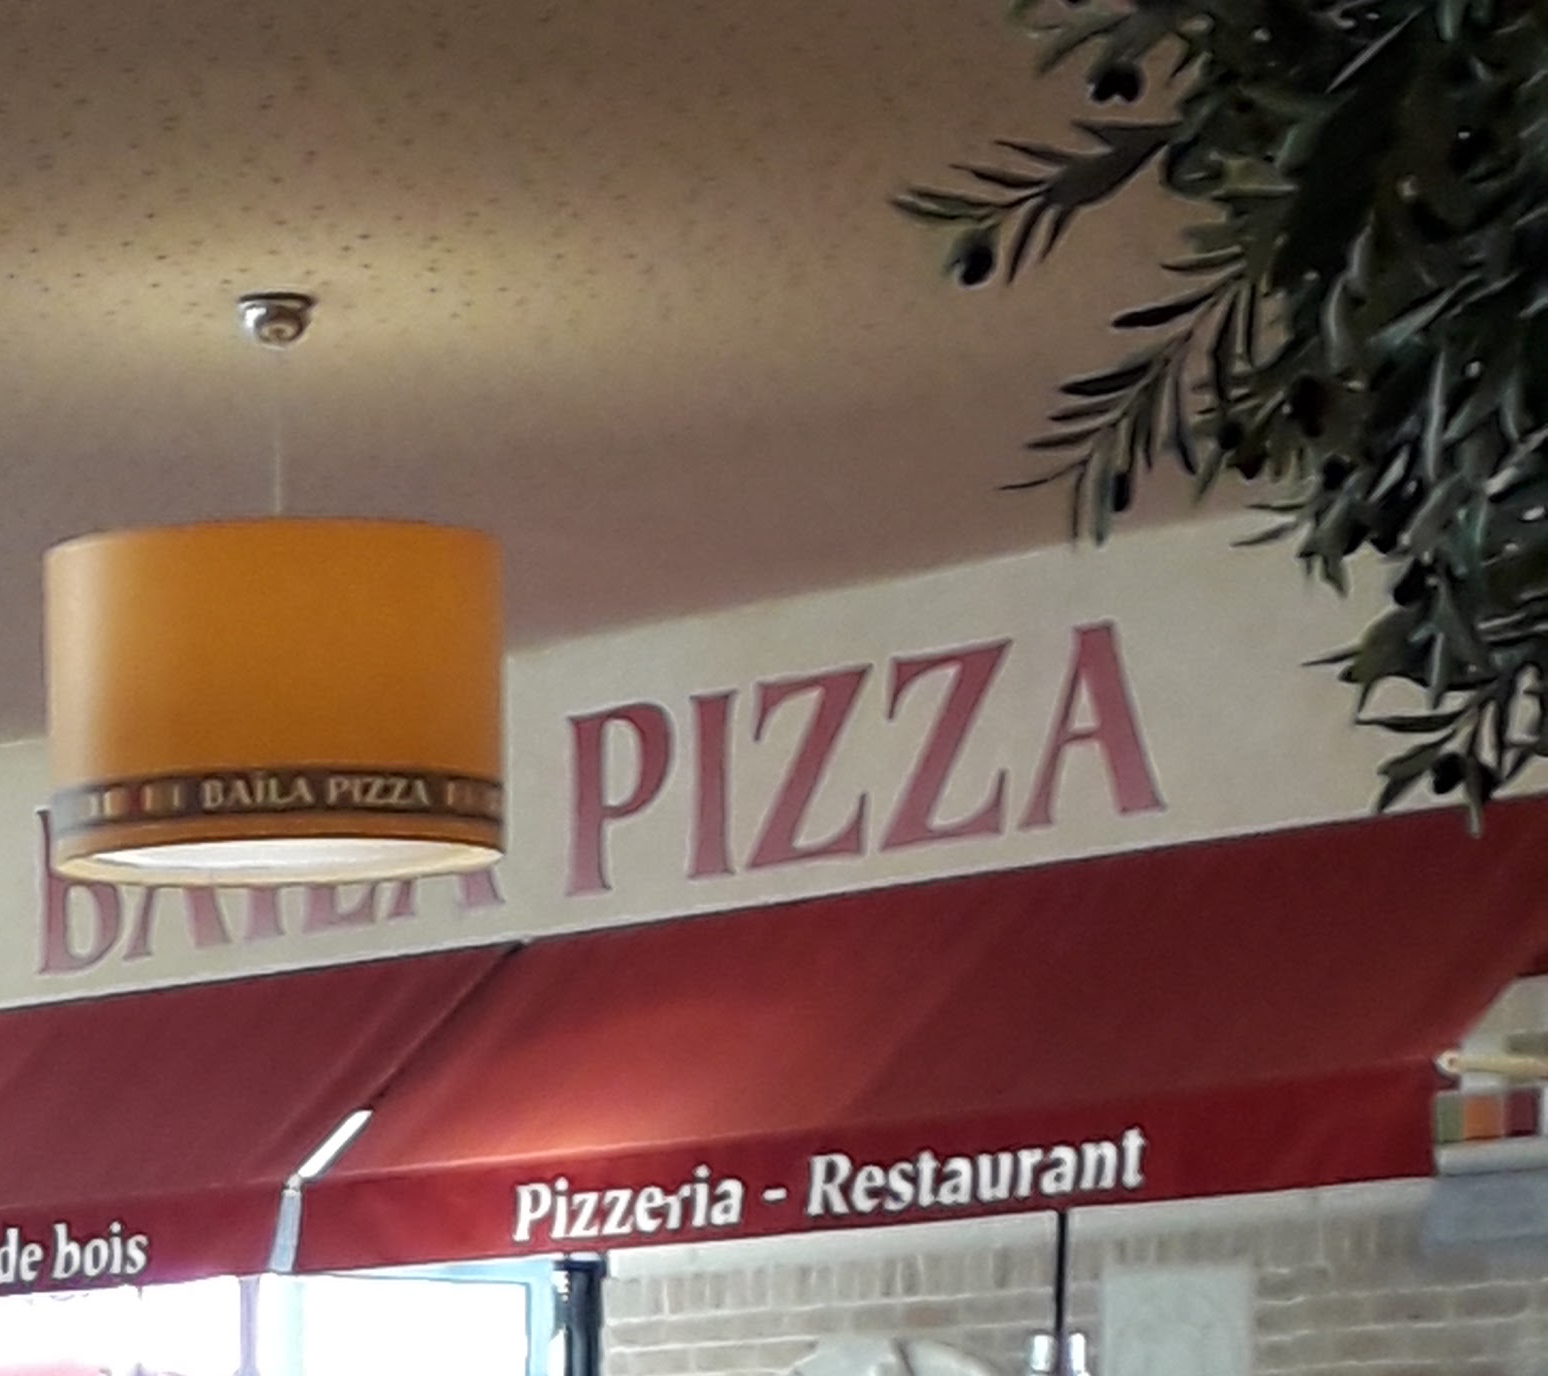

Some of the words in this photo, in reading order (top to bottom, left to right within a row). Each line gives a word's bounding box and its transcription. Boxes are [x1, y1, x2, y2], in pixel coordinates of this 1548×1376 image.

[326, 774, 431, 807] PIZZA
[564, 620, 1166, 898] PIZZA
[512, 1164, 745, 1243] Pizzeria
[762, 1187, 789, 1203] -
[805, 1126, 1147, 1217] Restaurant
[52, 1220, 149, 1281] bois
